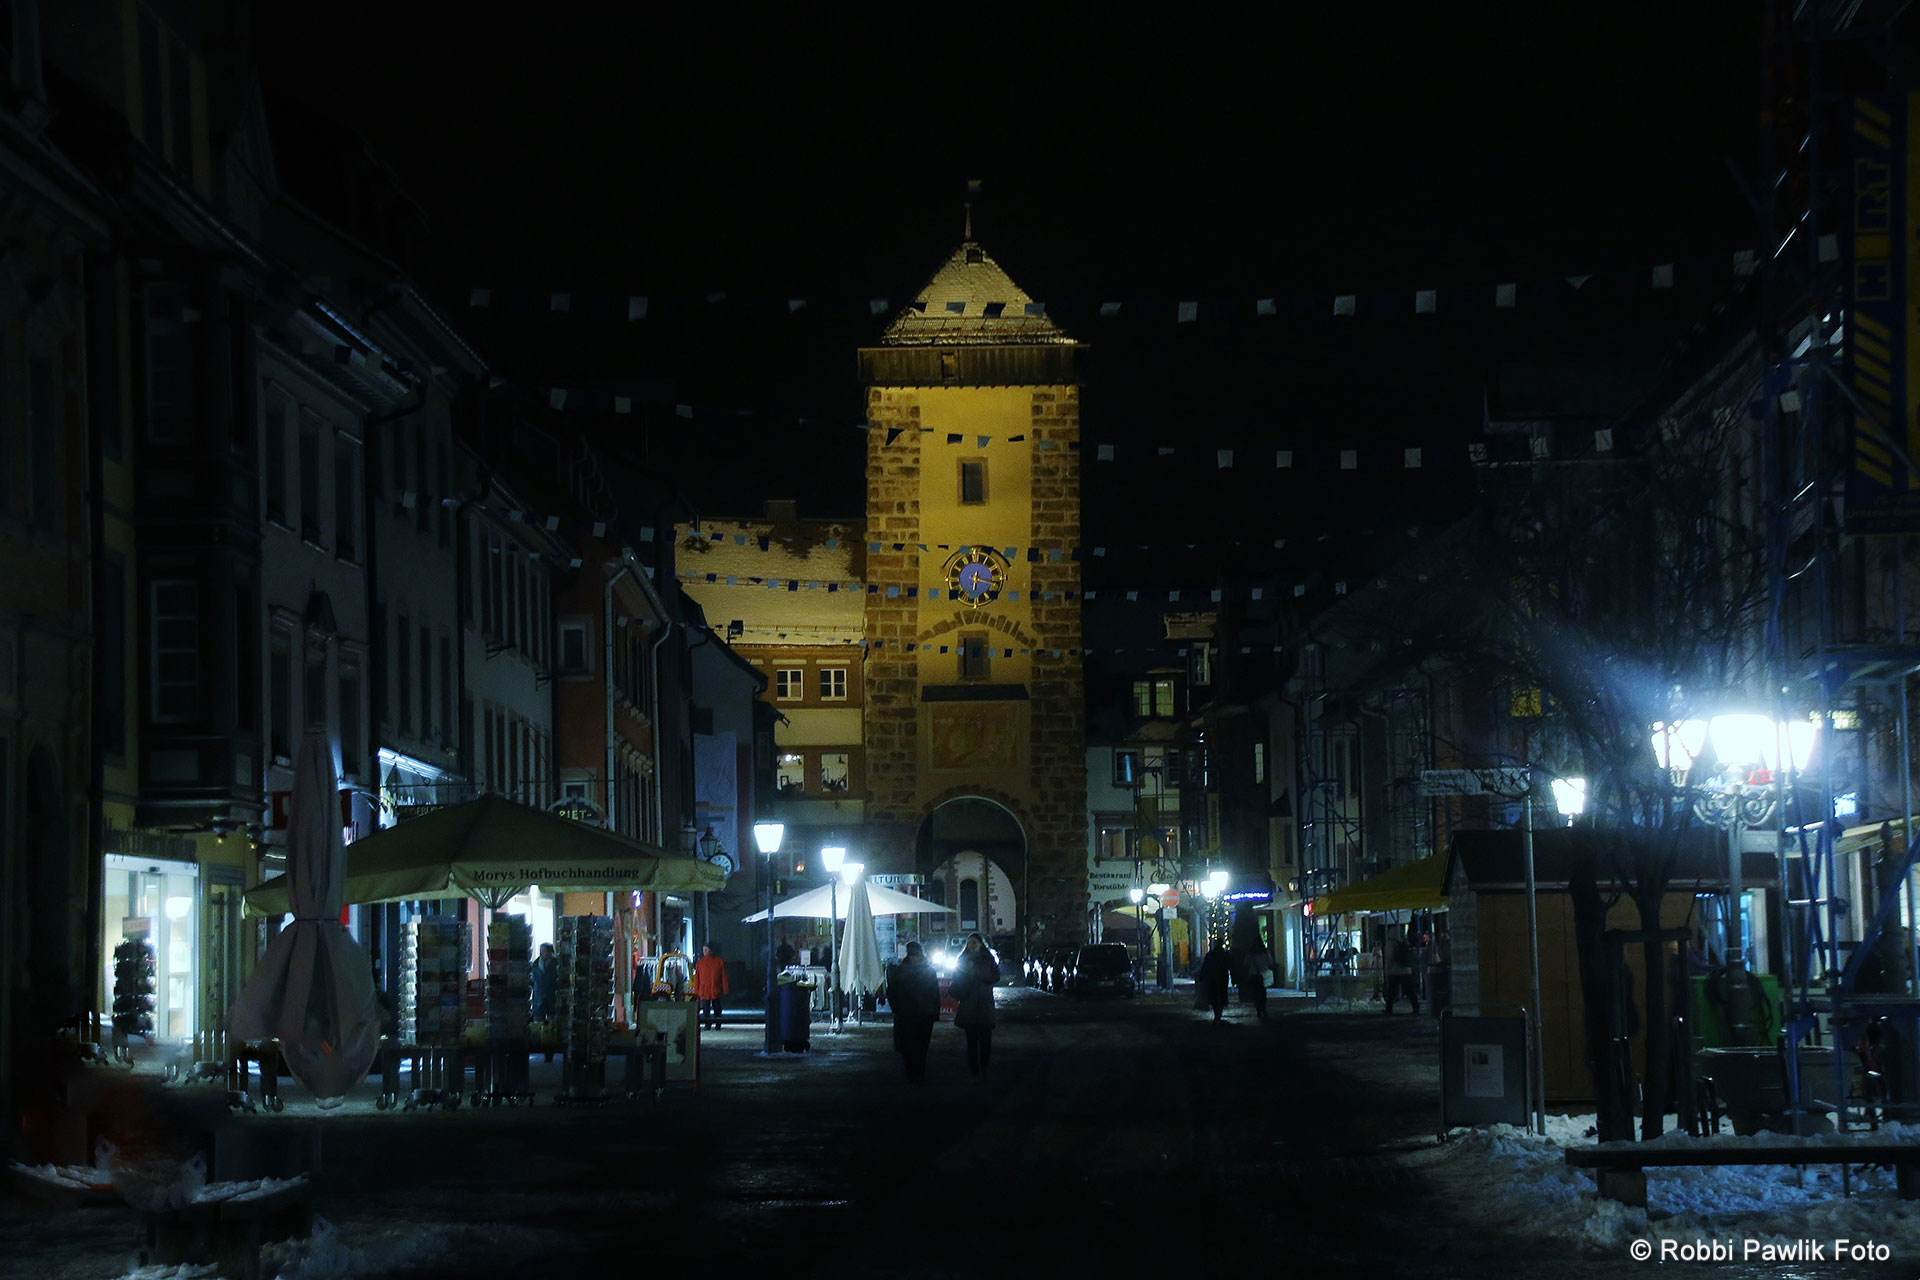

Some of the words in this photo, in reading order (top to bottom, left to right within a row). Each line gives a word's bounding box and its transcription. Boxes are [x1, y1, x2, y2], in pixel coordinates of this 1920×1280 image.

[473, 870, 515, 883] Morys
[519, 867, 640, 881] Hofbuchhandlung
[1089, 871, 1131, 880] Restaurant
